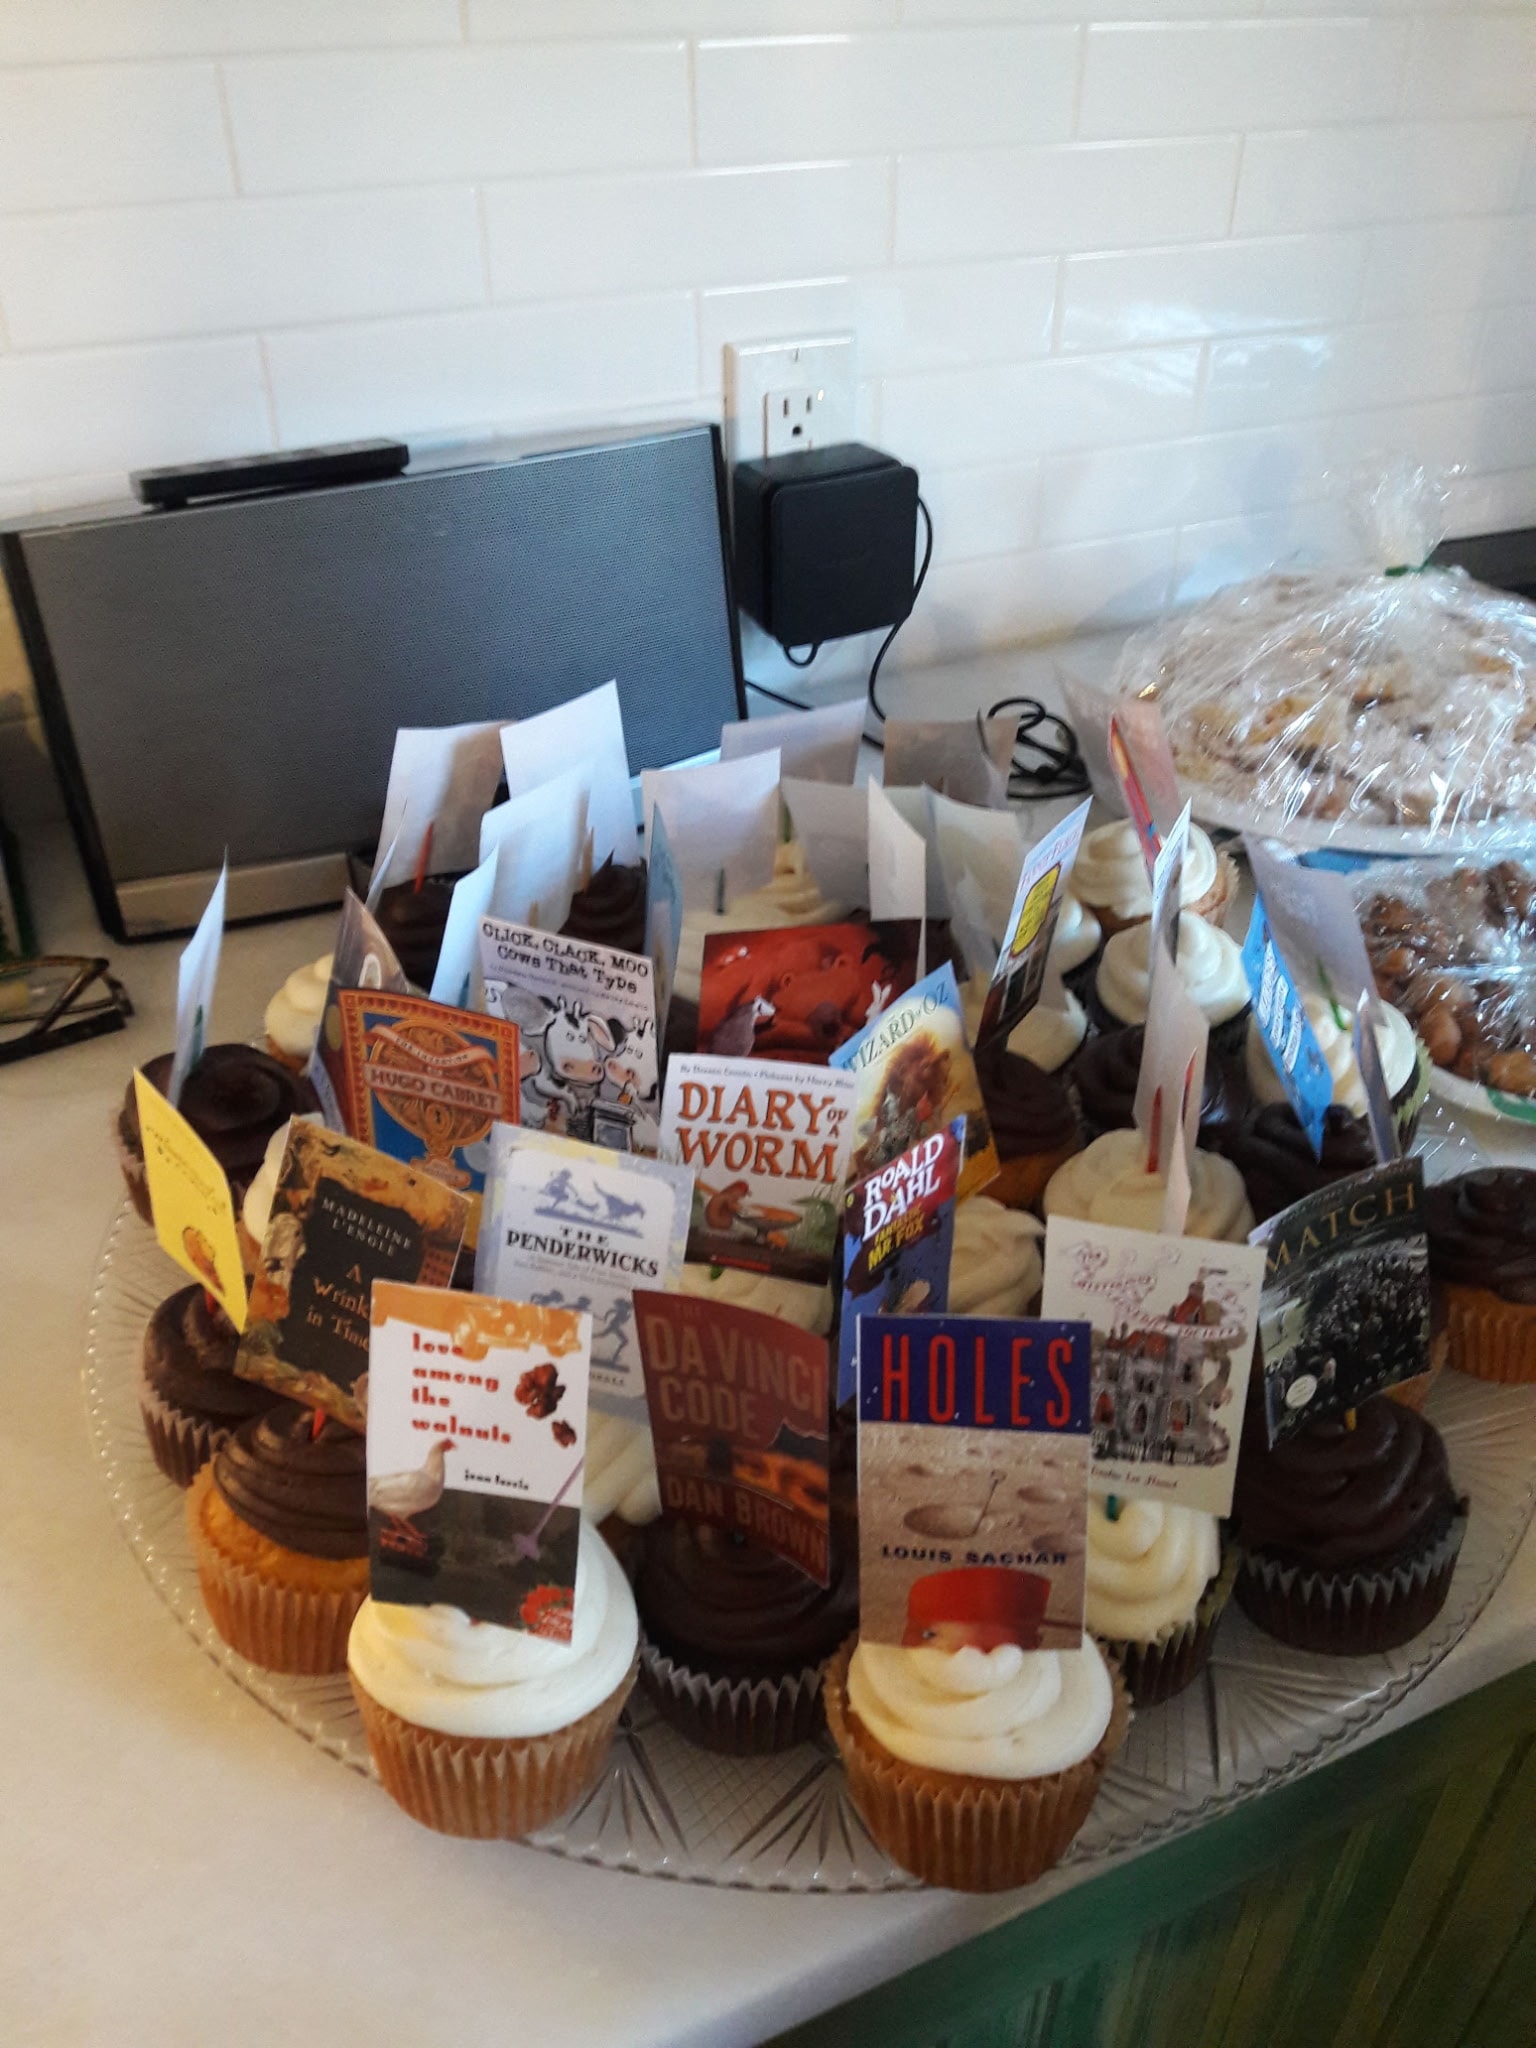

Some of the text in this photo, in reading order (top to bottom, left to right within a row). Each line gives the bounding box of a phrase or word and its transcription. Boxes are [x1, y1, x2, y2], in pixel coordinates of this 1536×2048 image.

[497, 945, 541, 968] Cows
[545, 957, 588, 979] That
[593, 968, 637, 994] Type
[610, 955, 648, 978] MOO
[923, 980, 949, 1015] OZ
[371, 1069, 425, 1092] HUGO
[431, 1080, 498, 1109] CABRET
[678, 1081, 849, 1137] DIARY OF
[828, 1123, 841, 1139] A
[675, 1127, 839, 1185] WORM
[864, 1133, 944, 1211] ROALD
[322, 1196, 411, 1250] MADELEINE
[862, 1164, 940, 1243] DAHL
[506, 1229, 659, 1277] PENDERWICKS
[560, 1225, 609, 1247] THE
[346, 1263, 362, 1284] A
[307, 1304, 323, 1328] in
[312, 1275, 370, 1320] Wrink
[412, 1333, 463, 1356] love
[412, 1366, 499, 1391] among
[644, 1315, 824, 1419] DA VINCI
[882, 1334, 1074, 1427] HOLES
[411, 1386, 450, 1408] the
[657, 1376, 760, 1440] CODE
[411, 1416, 512, 1444] walnuts
[666, 1477, 828, 1573] DAN BROWN
[882, 1545, 1068, 1567] LOUIS SACHAR
